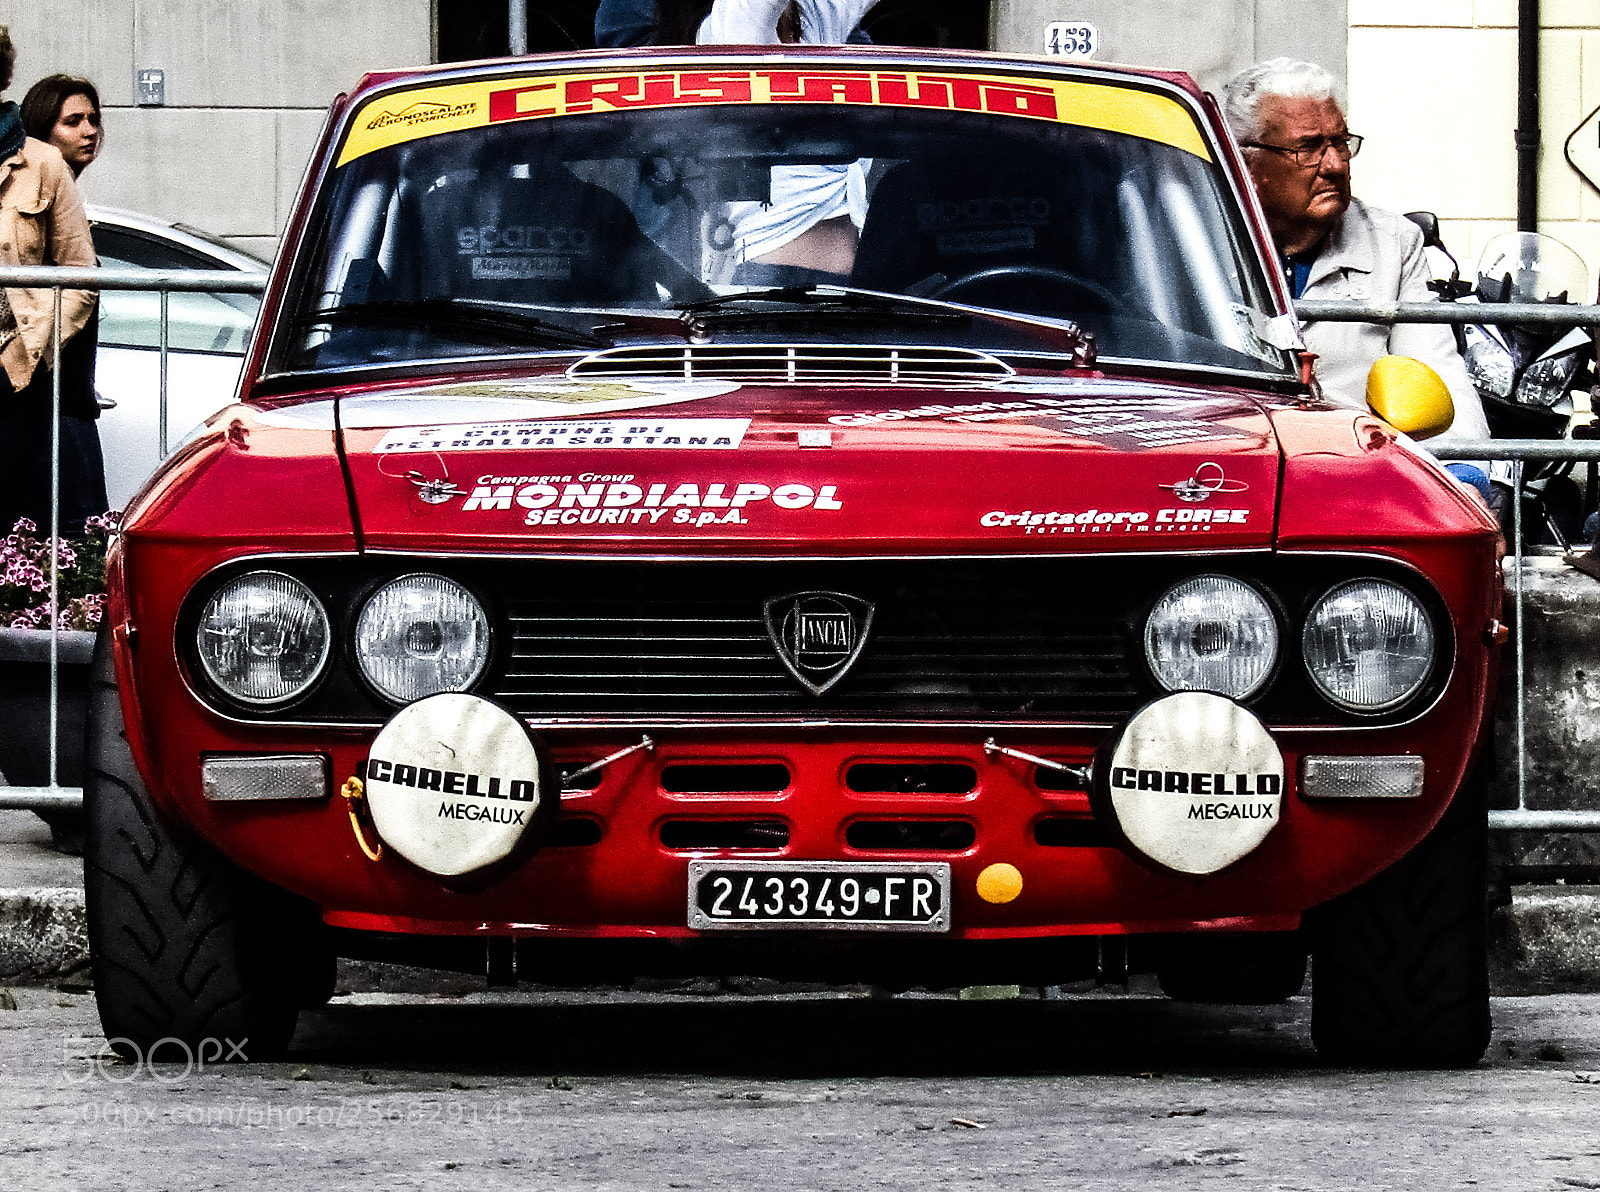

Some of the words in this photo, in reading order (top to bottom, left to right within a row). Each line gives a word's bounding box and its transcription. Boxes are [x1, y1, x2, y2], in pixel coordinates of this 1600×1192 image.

[1048, 27, 1092, 54] 453
[489, 71, 1058, 123] CRISTAUTO
[378, 102, 477, 128] CRONOSCALATE
[384, 437, 555, 450] PETRALIA
[568, 436, 732, 446] SOTTANA
[464, 426, 616, 437] COMUNE
[628, 426, 664, 434] DI
[477, 474, 572, 486] Campagna
[578, 472, 635, 485] Group
[461, 483, 844, 512] MONDIALPOL
[524, 508, 669, 526] SECURITY
[672, 508, 749, 527] S.p.A.
[979, 509, 1148, 527] Cristadoro
[1155, 509, 1250, 523] CORSE
[1025, 525, 1112, 534] Termini
[801, 616, 847, 650] LANCIA
[368, 758, 535, 802] CARELLO
[1112, 767, 1280, 795] CARELLO
[438, 802, 525, 825] MEGALUX
[1188, 803, 1273, 819] MEGALUX
